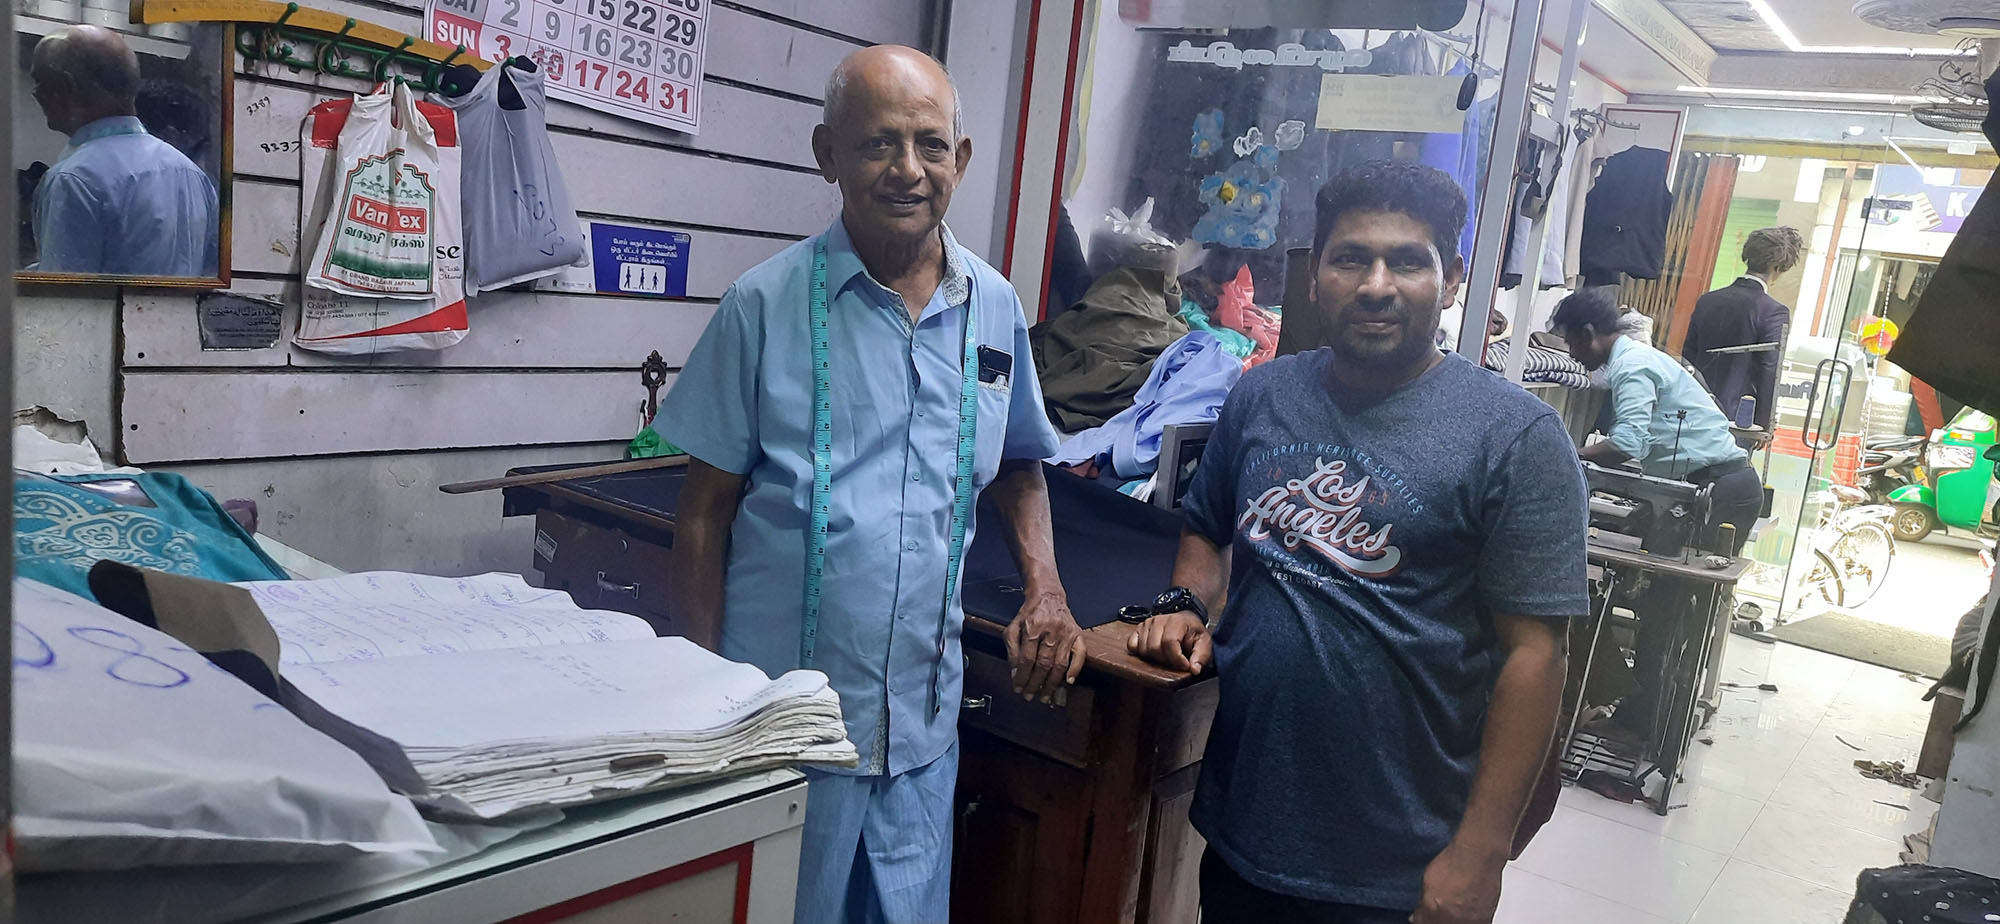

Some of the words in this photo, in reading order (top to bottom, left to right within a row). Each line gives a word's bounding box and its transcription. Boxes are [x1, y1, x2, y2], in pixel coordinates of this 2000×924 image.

[499, 0, 520, 28] 2
[545, 11, 561, 41] 9
[579, 24, 613, 57] 16
[620, 35, 653, 68] 23
[660, 48, 694, 79] 30
[624, 1, 659, 34] 22
[664, 14, 698, 46] 29
[436, 20, 476, 51] SUN
[493, 34, 511, 63] 3
[575, 60, 609, 91] 17
[616, 71, 650, 103] 24
[660, 83, 689, 114] 31
[1946, 191, 1968, 217] K
[435, 245, 461, 260] se
[1286, 456, 1371, 513] Los
[1374, 463, 1424, 515] SUPPLIES
[1237, 486, 1402, 575] Angeles
